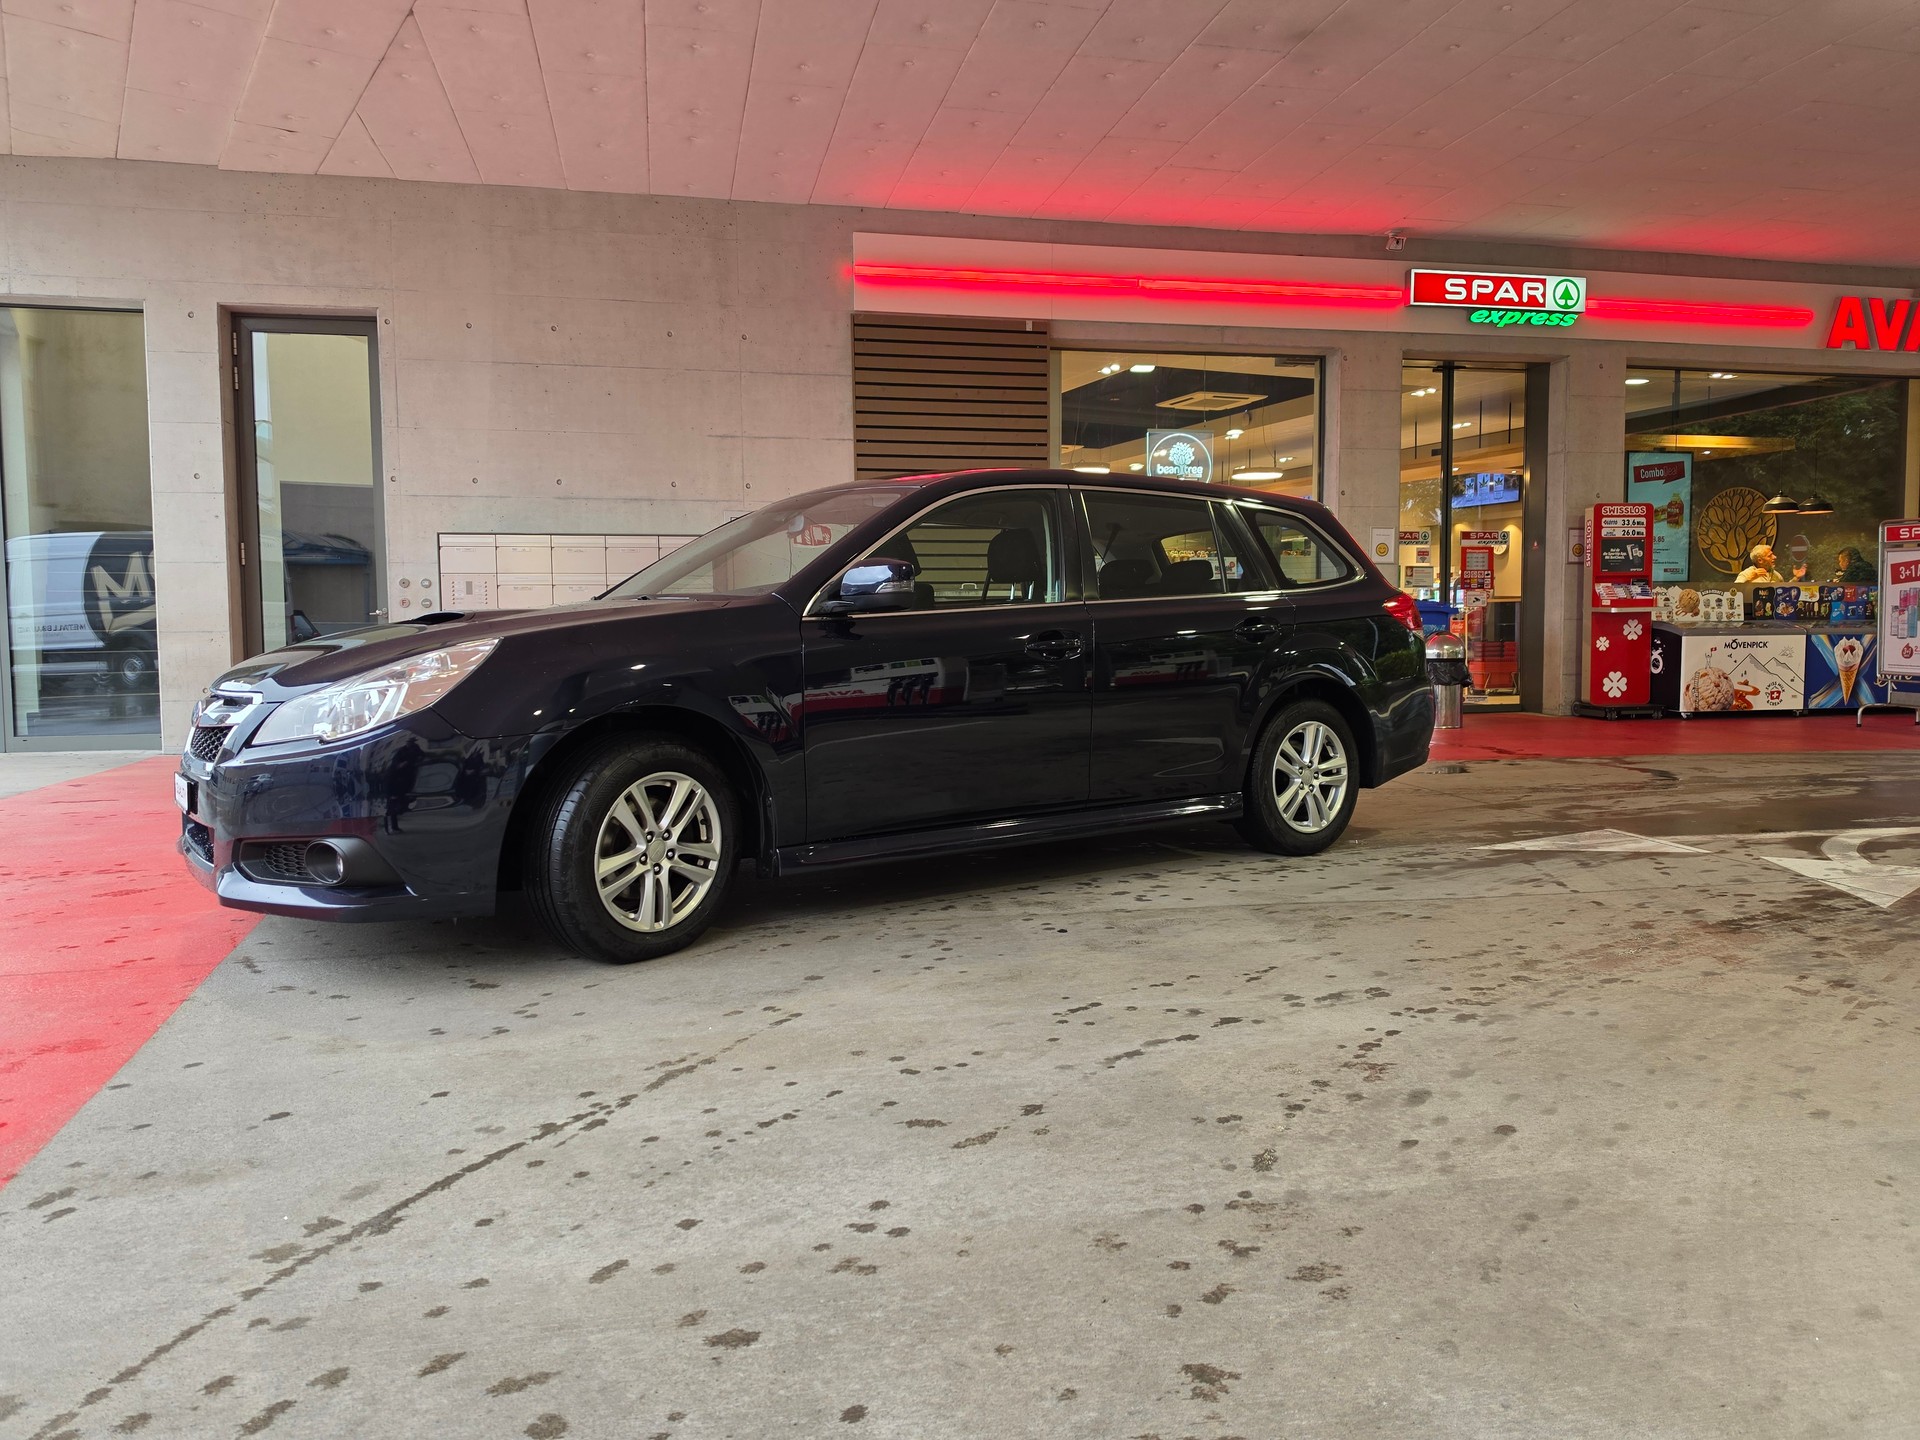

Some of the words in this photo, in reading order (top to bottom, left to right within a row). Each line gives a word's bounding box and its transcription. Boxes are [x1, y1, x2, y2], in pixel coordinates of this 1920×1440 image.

[1445, 278, 1544, 304] SPAR
[1470, 310, 1578, 327] express
[1157, 463, 1180, 475] bean
[1184, 464, 1204, 475] tree
[1602, 505, 1646, 516] SWISSLOS
